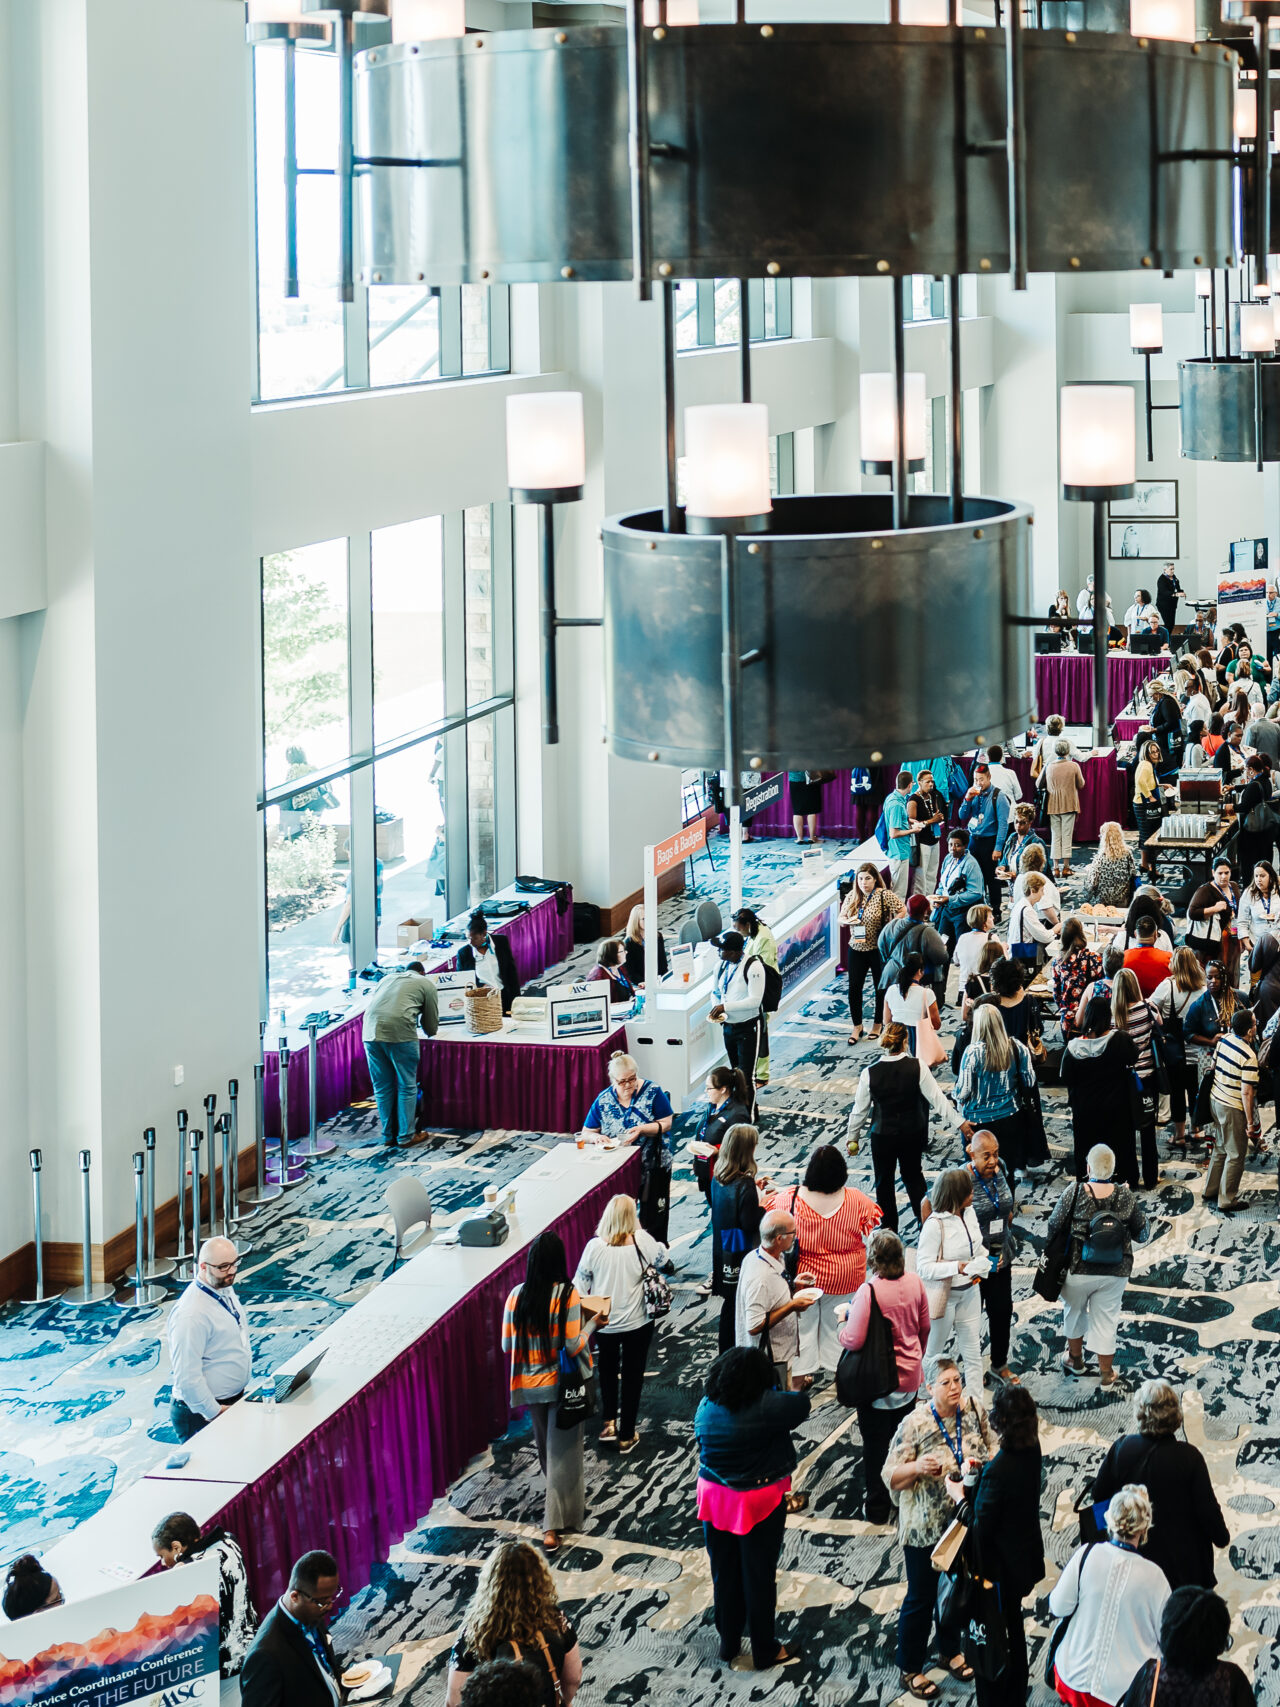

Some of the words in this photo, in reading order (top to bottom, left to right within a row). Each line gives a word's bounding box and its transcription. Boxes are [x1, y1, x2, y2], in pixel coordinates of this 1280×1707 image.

[745, 784, 780, 812] Registration
[656, 846, 674, 866] Bags
[680, 829, 703, 853] Badges
[565, 1388, 582, 1399] blu
[69, 1667, 139, 1697] Coordinator
[141, 1644, 204, 1672] Conference
[94, 1684, 129, 1707] THE
[133, 1659, 205, 1695] FUTURE
